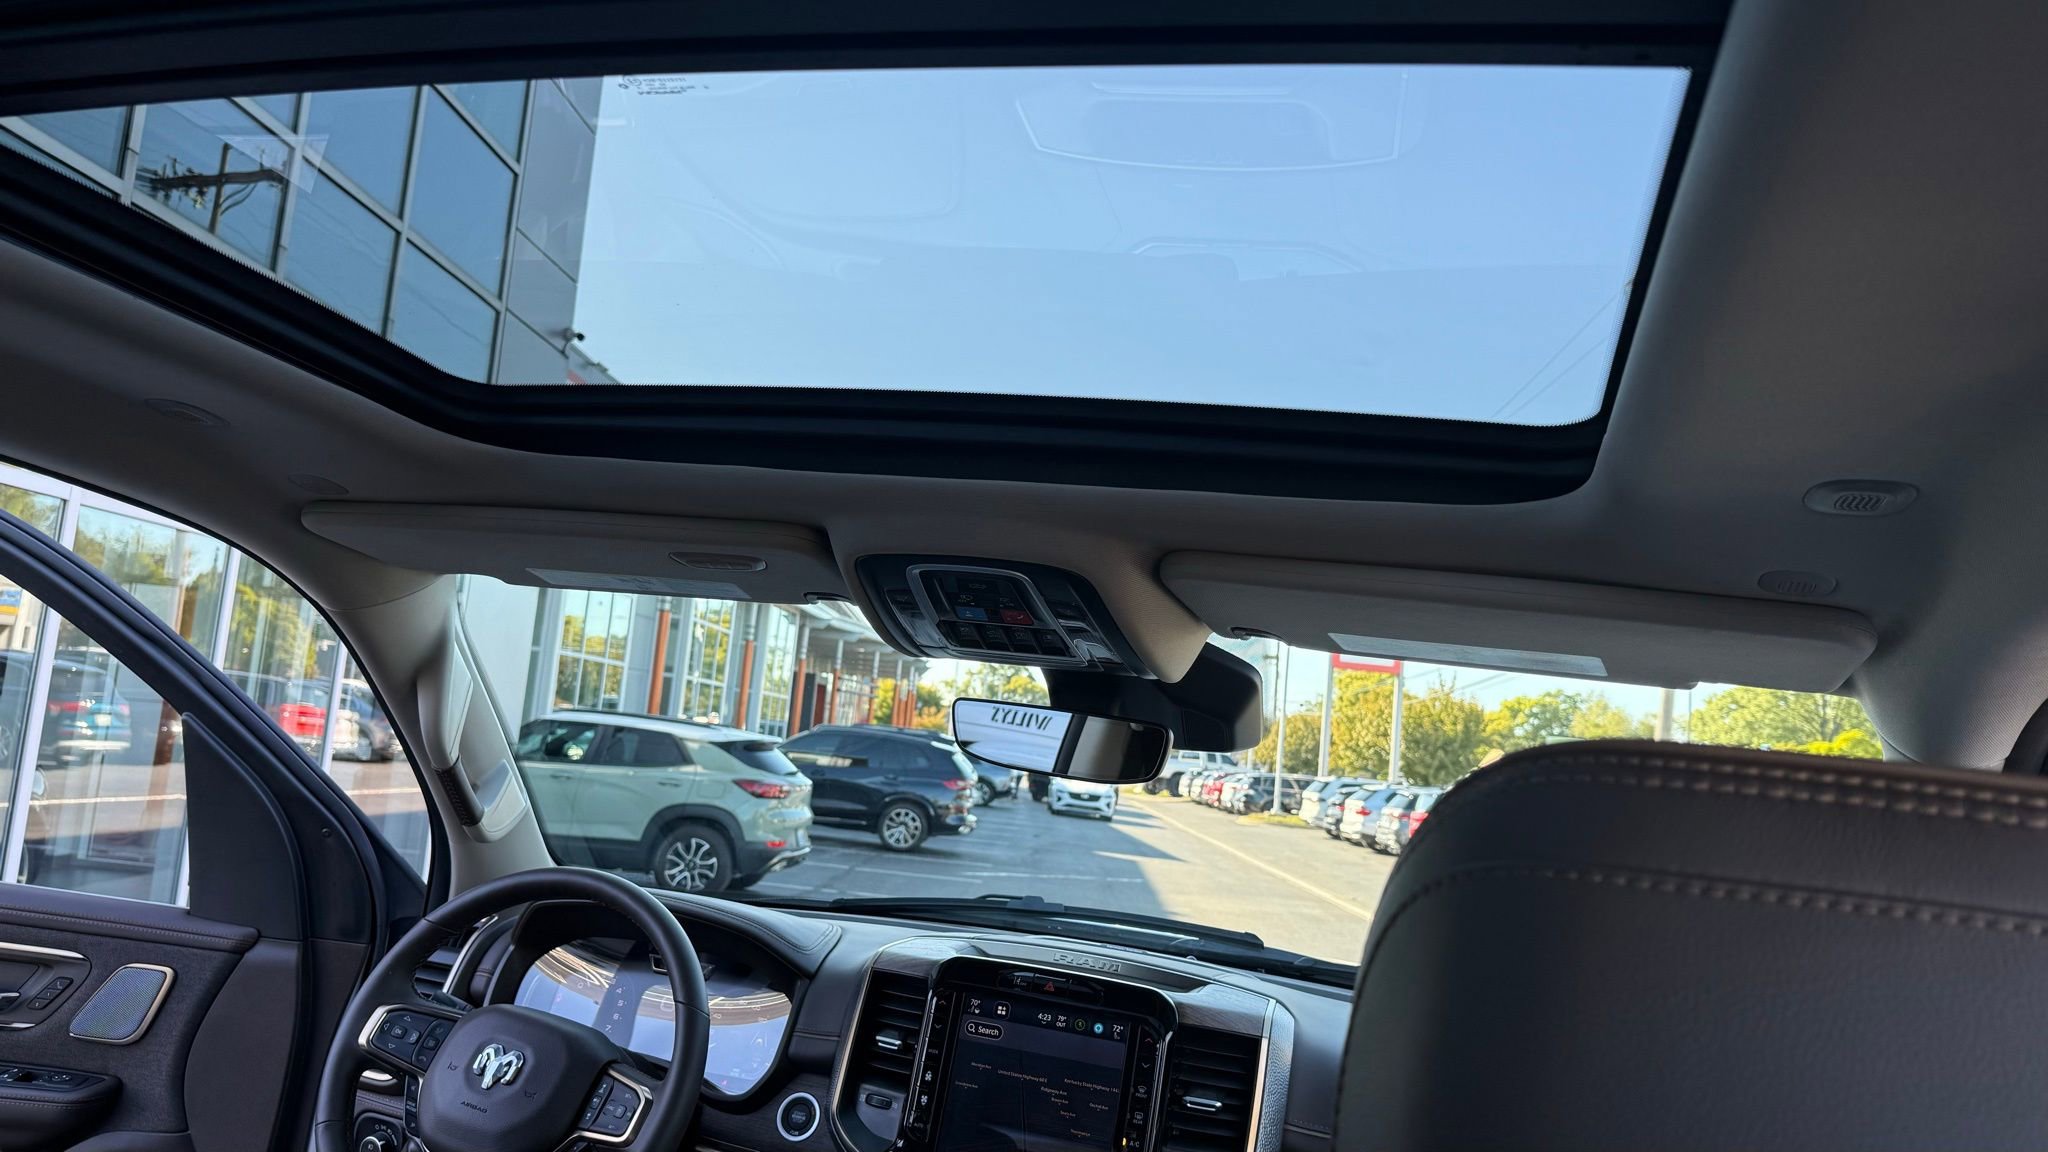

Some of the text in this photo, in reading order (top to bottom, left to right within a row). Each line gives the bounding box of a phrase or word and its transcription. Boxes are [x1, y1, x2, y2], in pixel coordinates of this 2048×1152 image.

[1053, 952, 1121, 973] RAM
[1037, 1012, 1052, 1022] 4:23
[977, 1026, 999, 1037] Search
